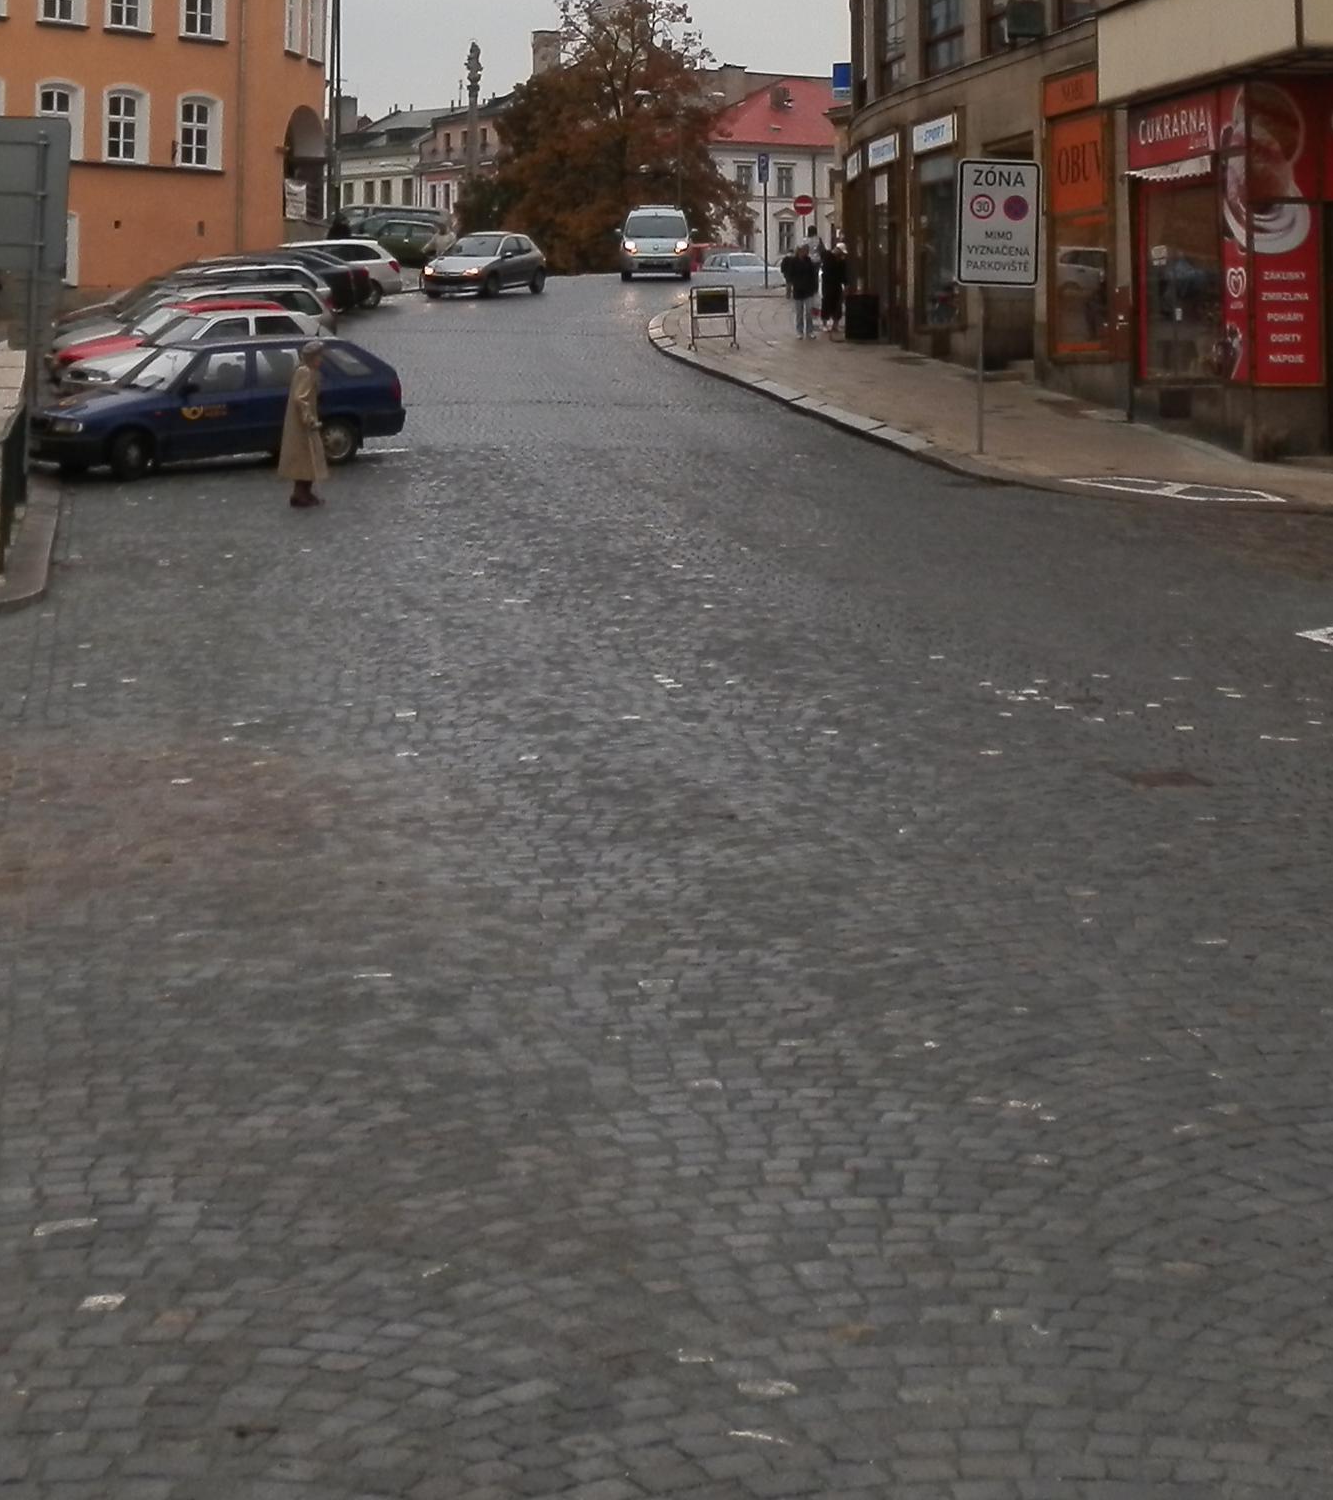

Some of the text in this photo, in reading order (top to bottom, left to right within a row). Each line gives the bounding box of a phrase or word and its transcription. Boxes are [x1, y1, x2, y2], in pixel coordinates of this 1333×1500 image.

[973, 166, 1025, 187] ZÓNA
[976, 201, 989, 212] 30
[985, 231, 1012, 240] MIMO
